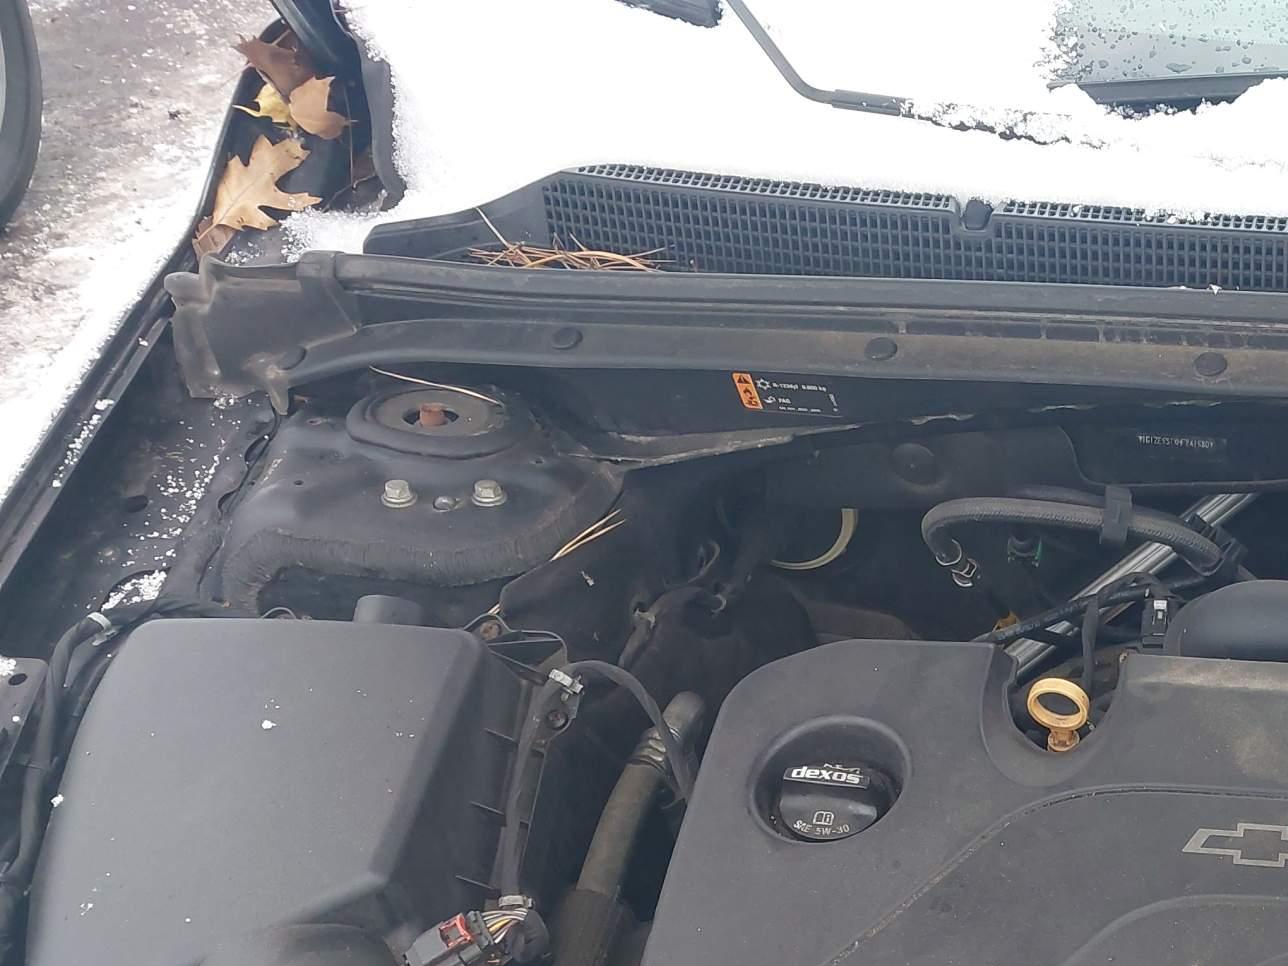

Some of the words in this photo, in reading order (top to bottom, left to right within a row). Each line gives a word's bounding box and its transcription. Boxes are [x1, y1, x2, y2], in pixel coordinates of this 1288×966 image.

[791, 766, 864, 784] dexos
[793, 819, 812, 833] SAE
[814, 823, 850, 836] 5W-30
